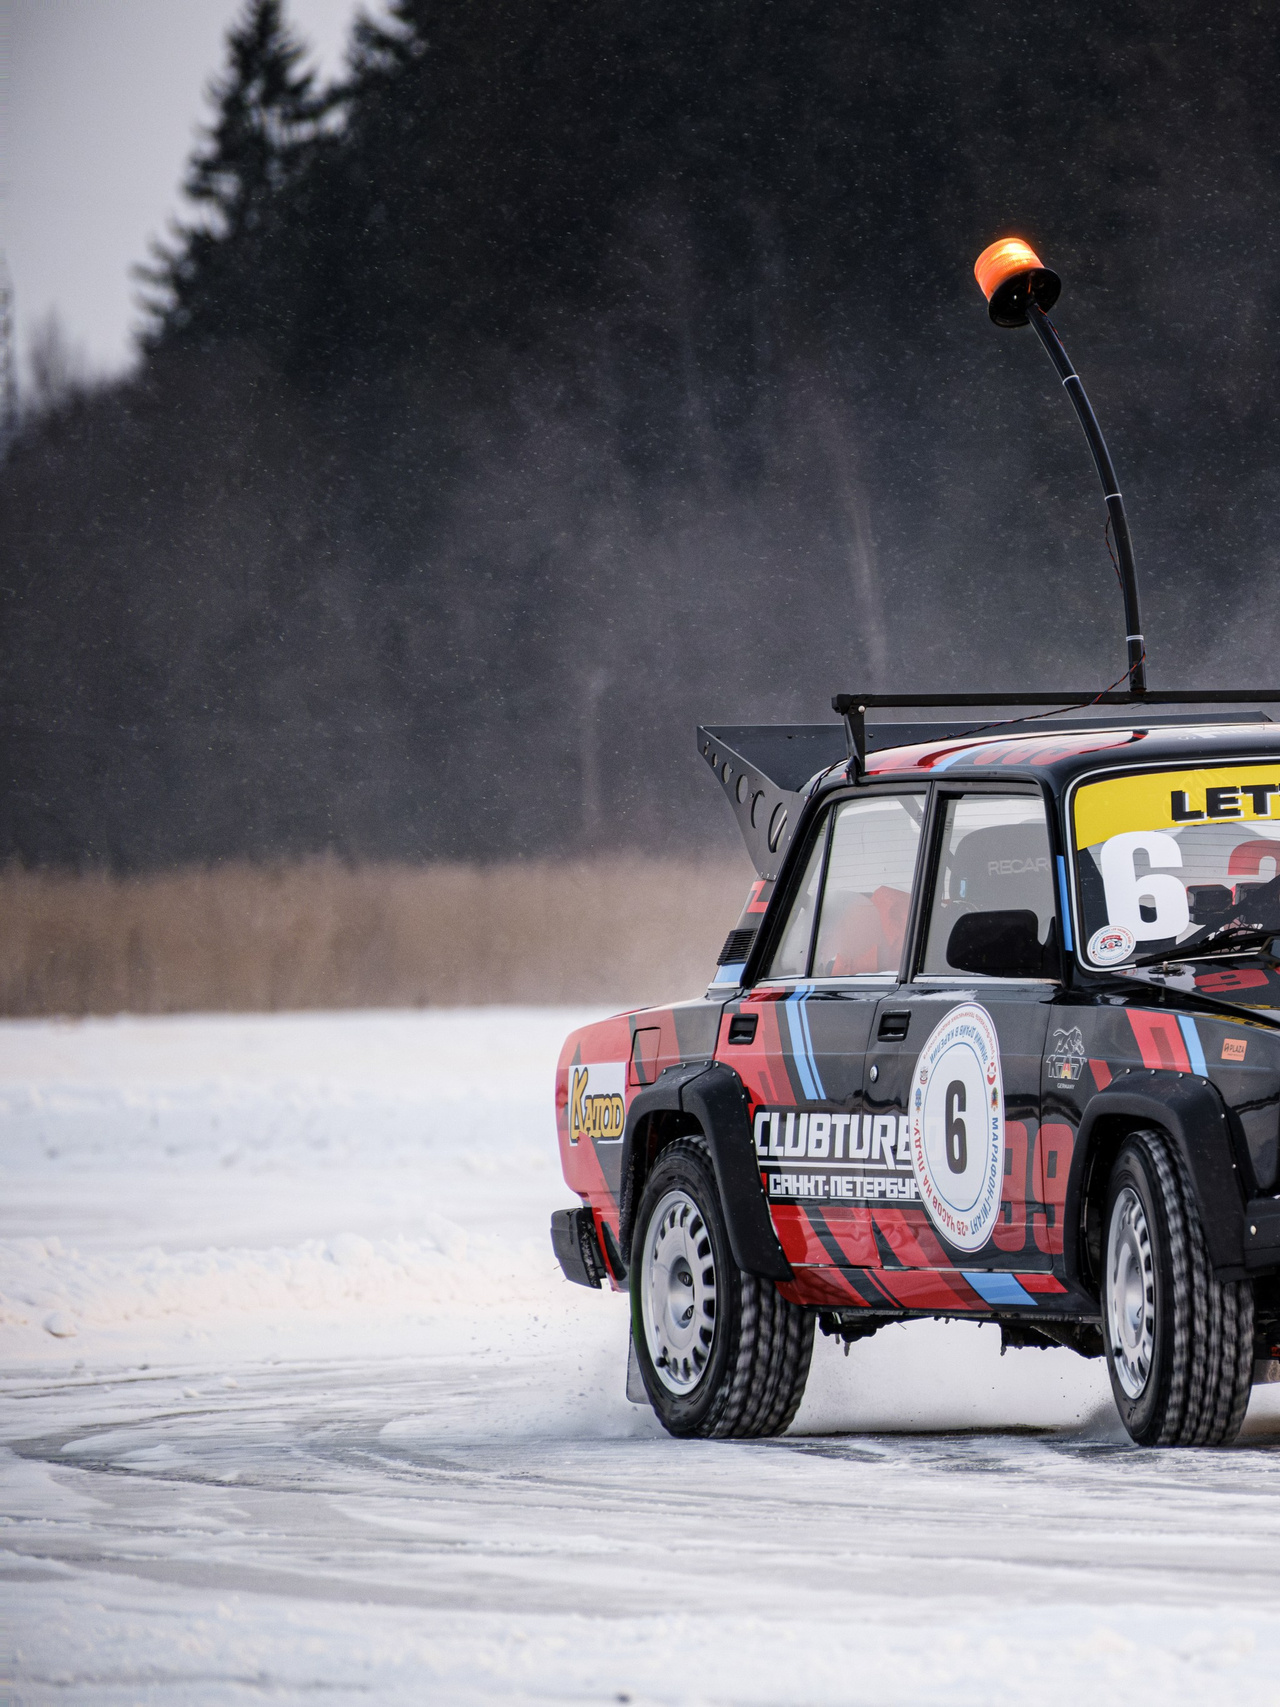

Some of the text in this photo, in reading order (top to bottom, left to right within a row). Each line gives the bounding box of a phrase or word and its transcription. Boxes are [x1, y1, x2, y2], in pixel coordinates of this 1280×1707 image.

[987, 857, 1051, 876] RECAR
[1100, 831, 1190, 941] 6
[923, 1174, 933, 1198] НА
[932, 1195, 955, 1232] ЧАСОВ
